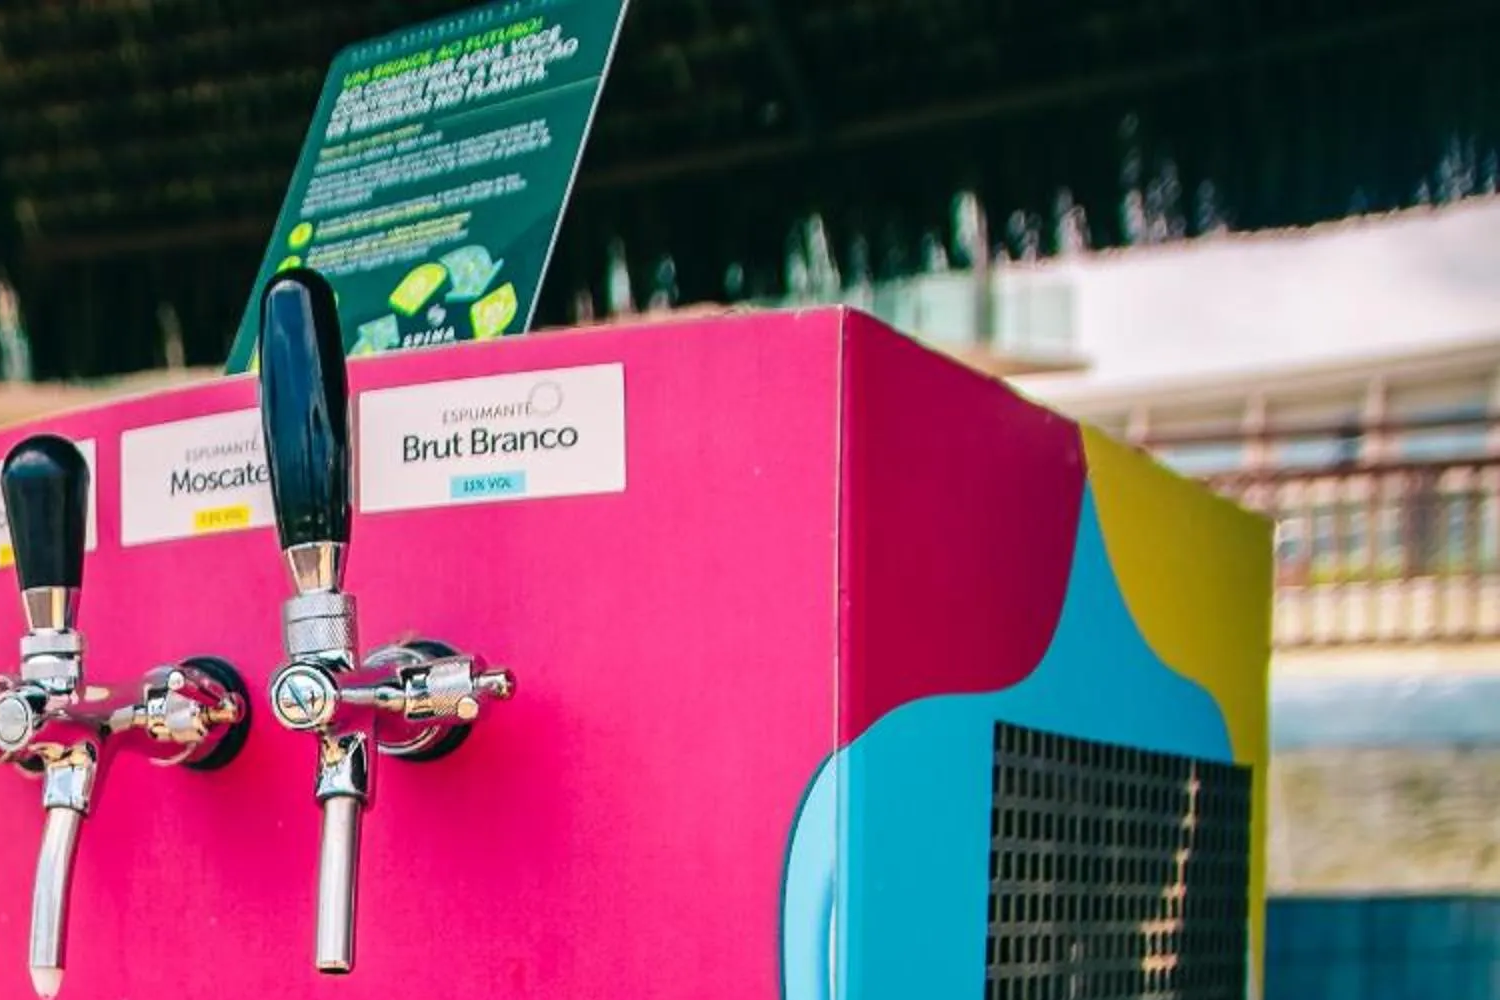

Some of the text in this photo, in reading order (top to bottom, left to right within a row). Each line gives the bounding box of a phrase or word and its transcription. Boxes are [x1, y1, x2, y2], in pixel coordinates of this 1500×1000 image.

[441, 401, 534, 425] ESPUMANTE
[403, 426, 579, 463] Brut Branco
[170, 460, 270, 496] Moscate
